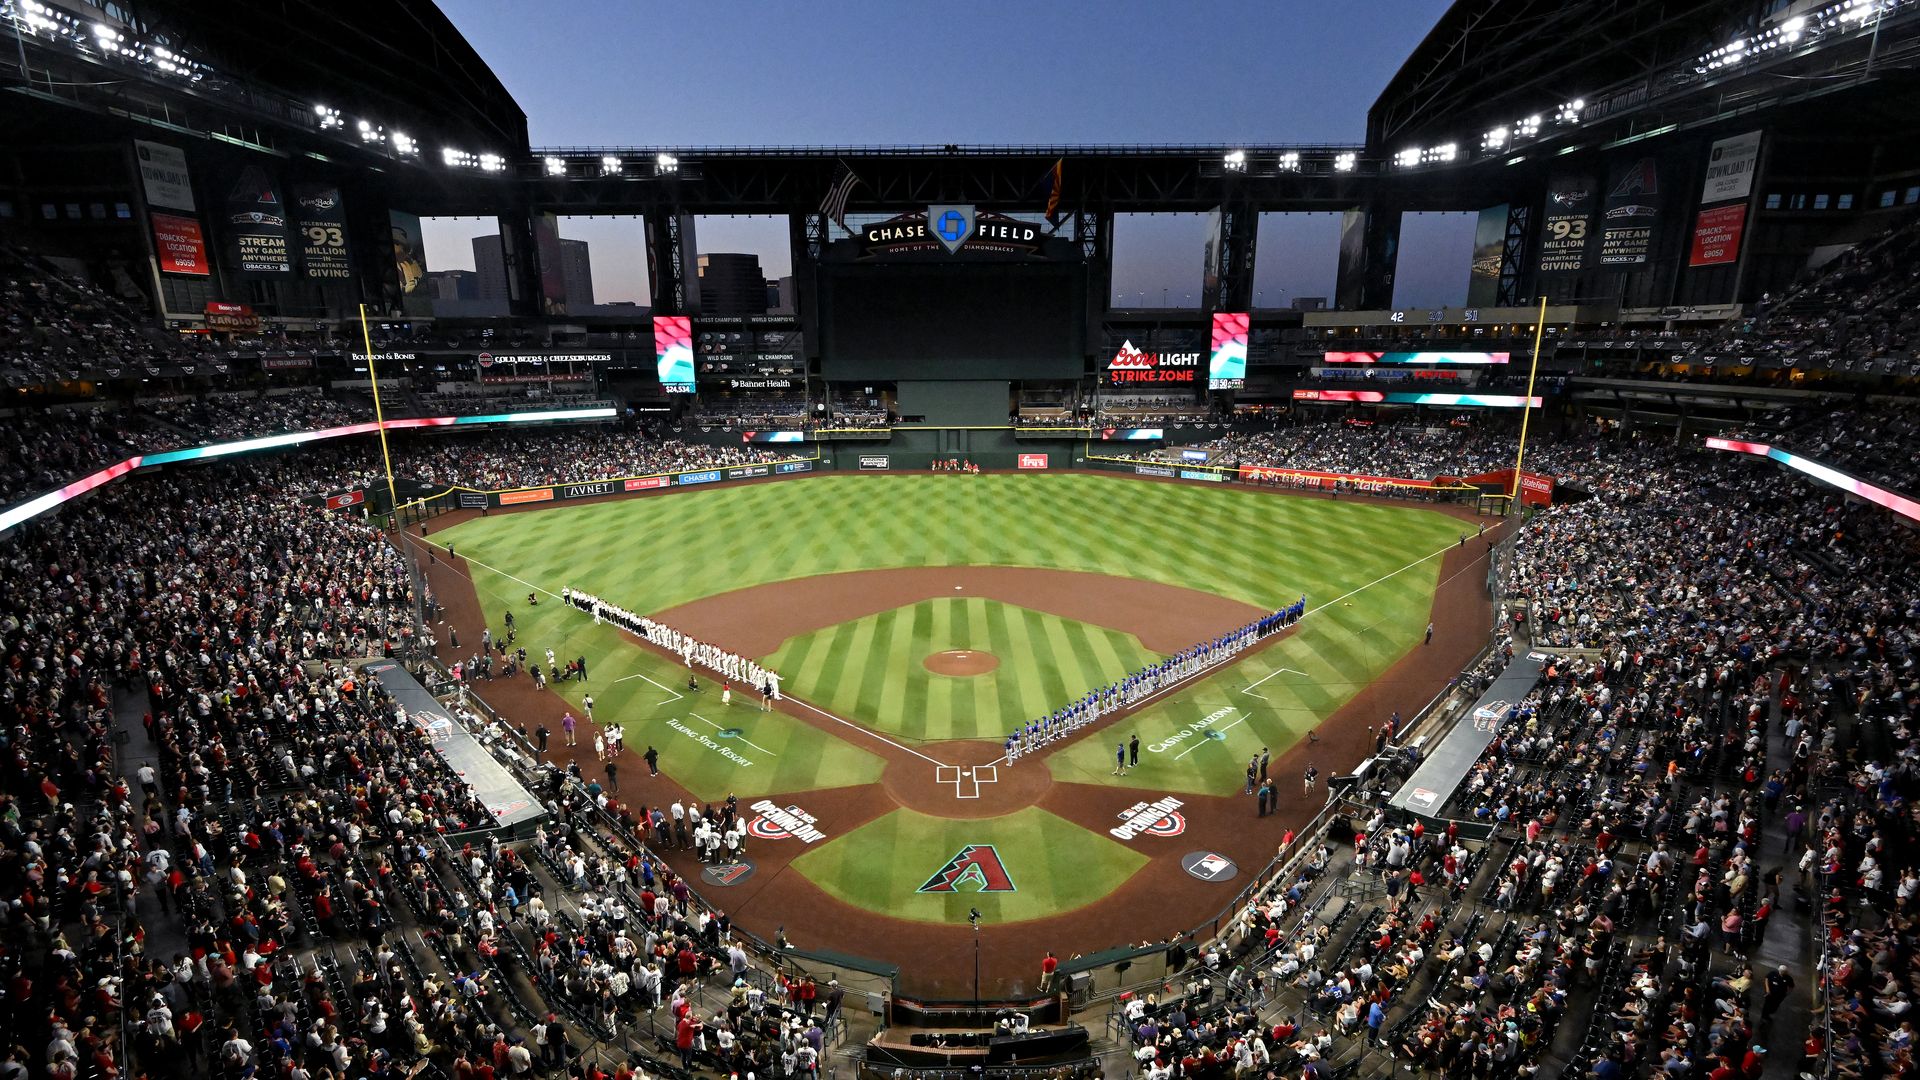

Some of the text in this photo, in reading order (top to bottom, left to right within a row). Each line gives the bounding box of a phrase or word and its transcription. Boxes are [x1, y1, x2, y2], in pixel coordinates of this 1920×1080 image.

[1708, 159, 1755, 179] DOWNLOAD IT
[869, 225, 1035, 242] CHASE FIELD
[1547, 220, 1587, 240] $93
[1604, 230, 1650, 239] STREAM
[302, 227, 344, 247] $93
[1702, 234, 1731, 244] LOCATION
[166, 242, 197, 253] LOCATION
[238, 238, 285, 247] STREAM
[1544, 240, 1585, 249] MILLION
[305, 247, 346, 255] MILLION
[964, 244, 1014, 252] DIAMONDBACKS
[1704, 249, 1723, 258] 69050
[1541, 262, 1581, 271] GIVING
[309, 269, 350, 278] GIVING
[1391, 312, 1404, 322] 42
[1428, 311, 1444, 321] 20
[1464, 309, 1478, 321] 51
[210, 315, 257, 326] SANDLOT
[550, 354, 611, 362] CHEESEBURGERS
[1112, 347, 1200, 367] Coors LIGHT
[1111, 370, 1194, 382] STRIKE ZONE
[684, 474, 709, 482] CHASE
[570, 484, 609, 495] AVNET
[1147, 706, 1237, 753] CASINO ARIZONA
[750, 800, 826, 843] OPENING DAY
[1110, 796, 1184, 840] OPENING DAY
[1334, 990, 1342, 998] 23
